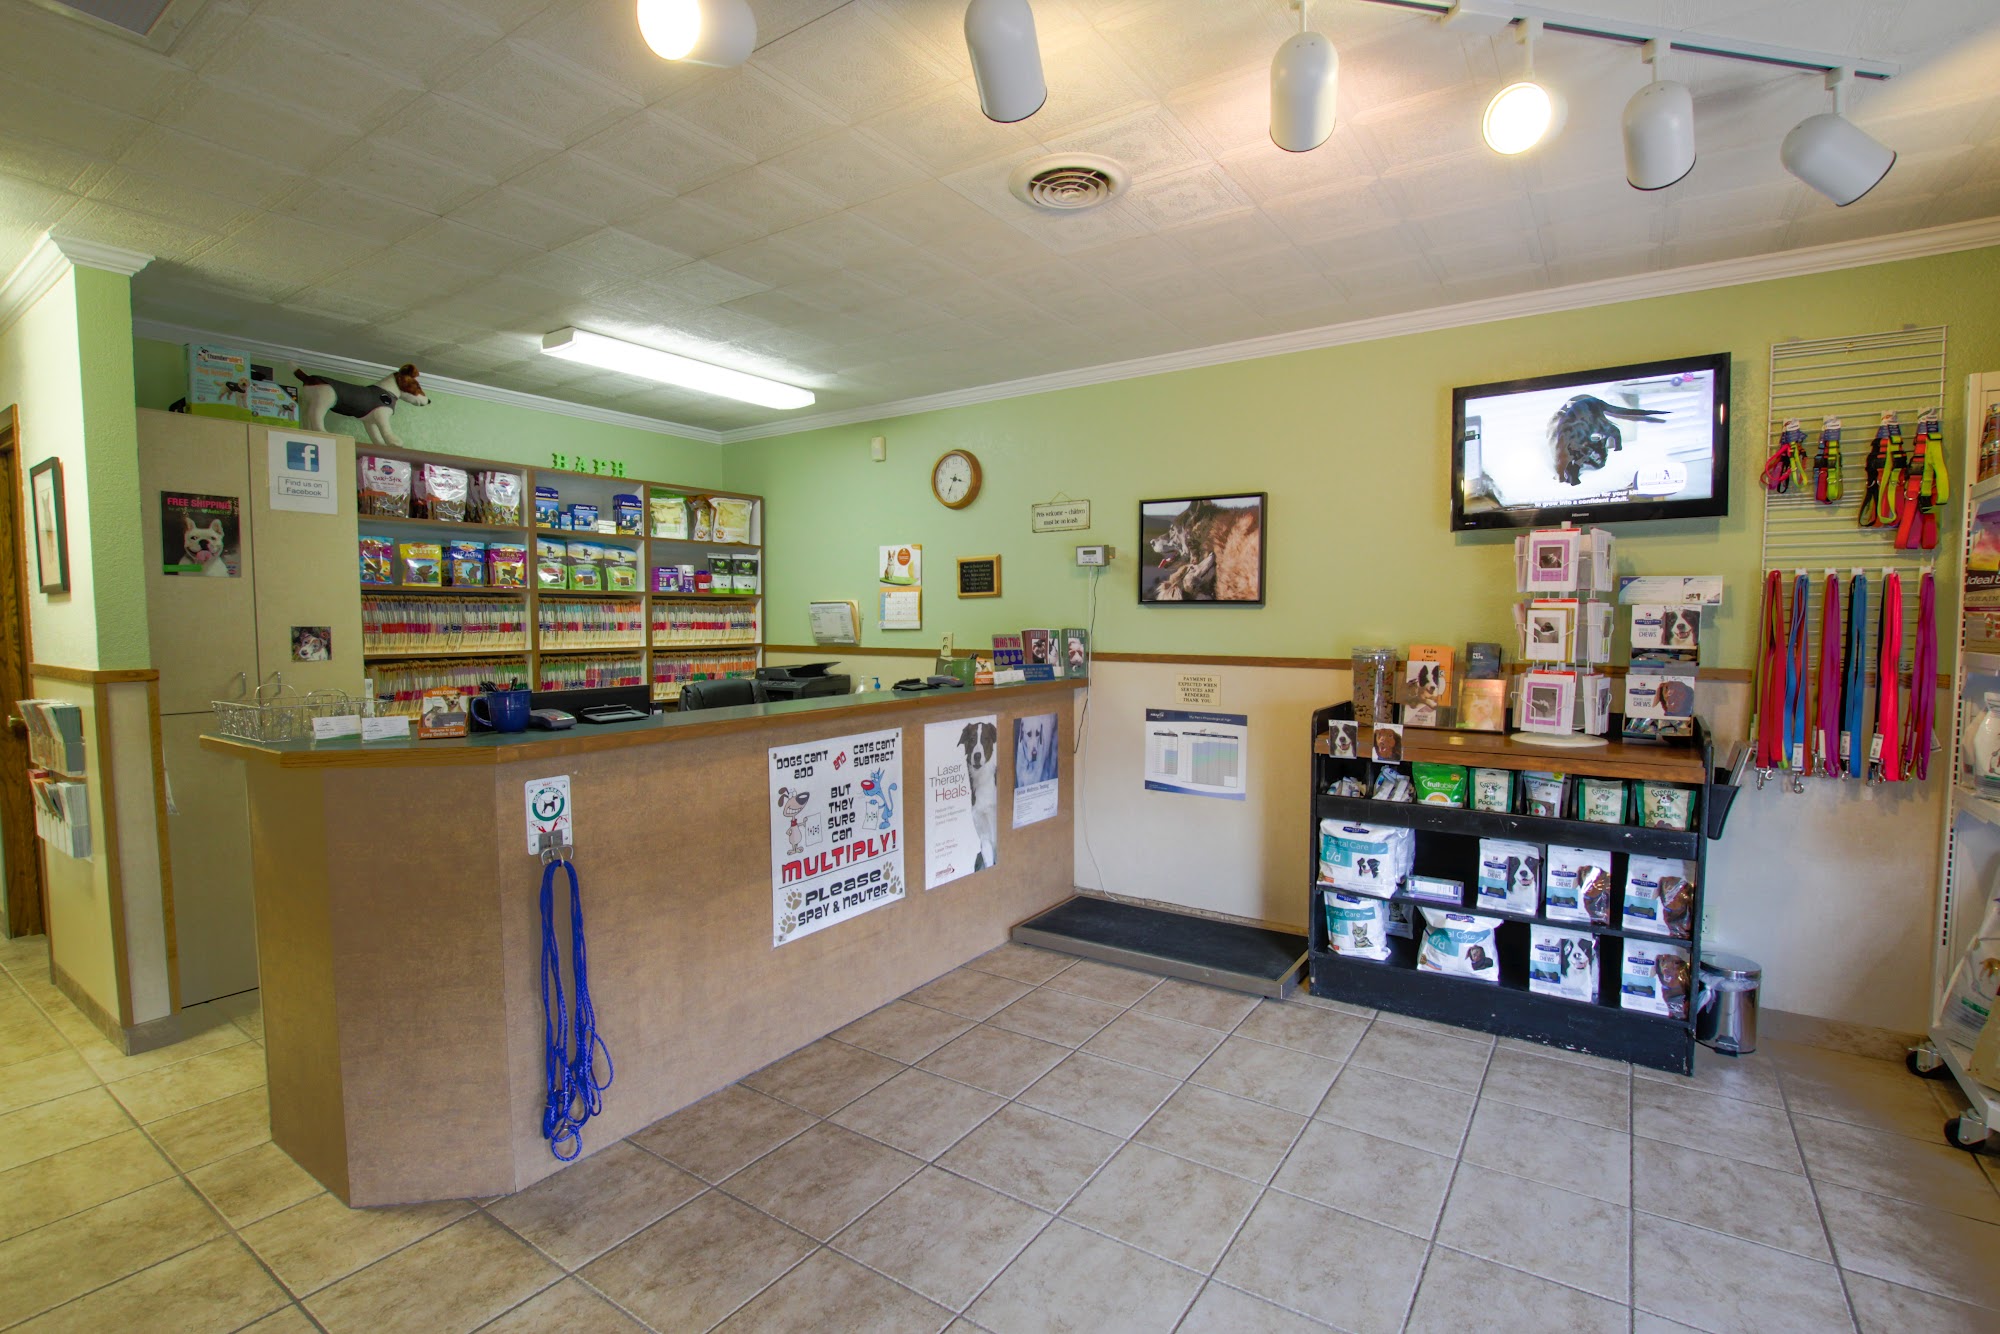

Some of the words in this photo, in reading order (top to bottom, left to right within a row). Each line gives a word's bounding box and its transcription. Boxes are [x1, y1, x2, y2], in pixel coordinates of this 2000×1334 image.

[285, 479, 301, 487] Find
[286, 487, 322, 496] Facebook
[167, 497, 189, 507] FREE
[191, 499, 231, 510] SHIPPING
[1967, 575, 1993, 585] ideal
[994, 637, 1008, 648] WAG
[1009, 637, 1021, 648] TAG
[776, 755, 802, 770] DOGS
[853, 743, 874, 755] CATS
[853, 751, 894, 767] SUBTRACT
[937, 763, 962, 776] Laser
[929, 773, 966, 788] Therapy
[1427, 781, 1458, 789] fruitables
[831, 783, 851, 798] BUT
[935, 784, 970, 802] Heals.
[1650, 789, 1680, 800] Greenies
[829, 797, 854, 814] THEY
[1478, 799, 1504, 807] Pockets
[827, 812, 856, 829] SURE
[1649, 810, 1681, 819] Pockets
[831, 827, 853, 843] CAN
[1328, 836, 1349, 849] Dental
[1350, 842, 1369, 851] Care
[782, 829, 896, 884] MULTIPLY!
[1326, 851, 1341, 862] t/d
[805, 869, 881, 906] PLEASE
[797, 903, 830, 926] SPAY
[833, 900, 840, 913] &
[843, 882, 888, 910] NEUTER
[1344, 910, 1361, 918] Care
[1457, 932, 1476, 940] Care
